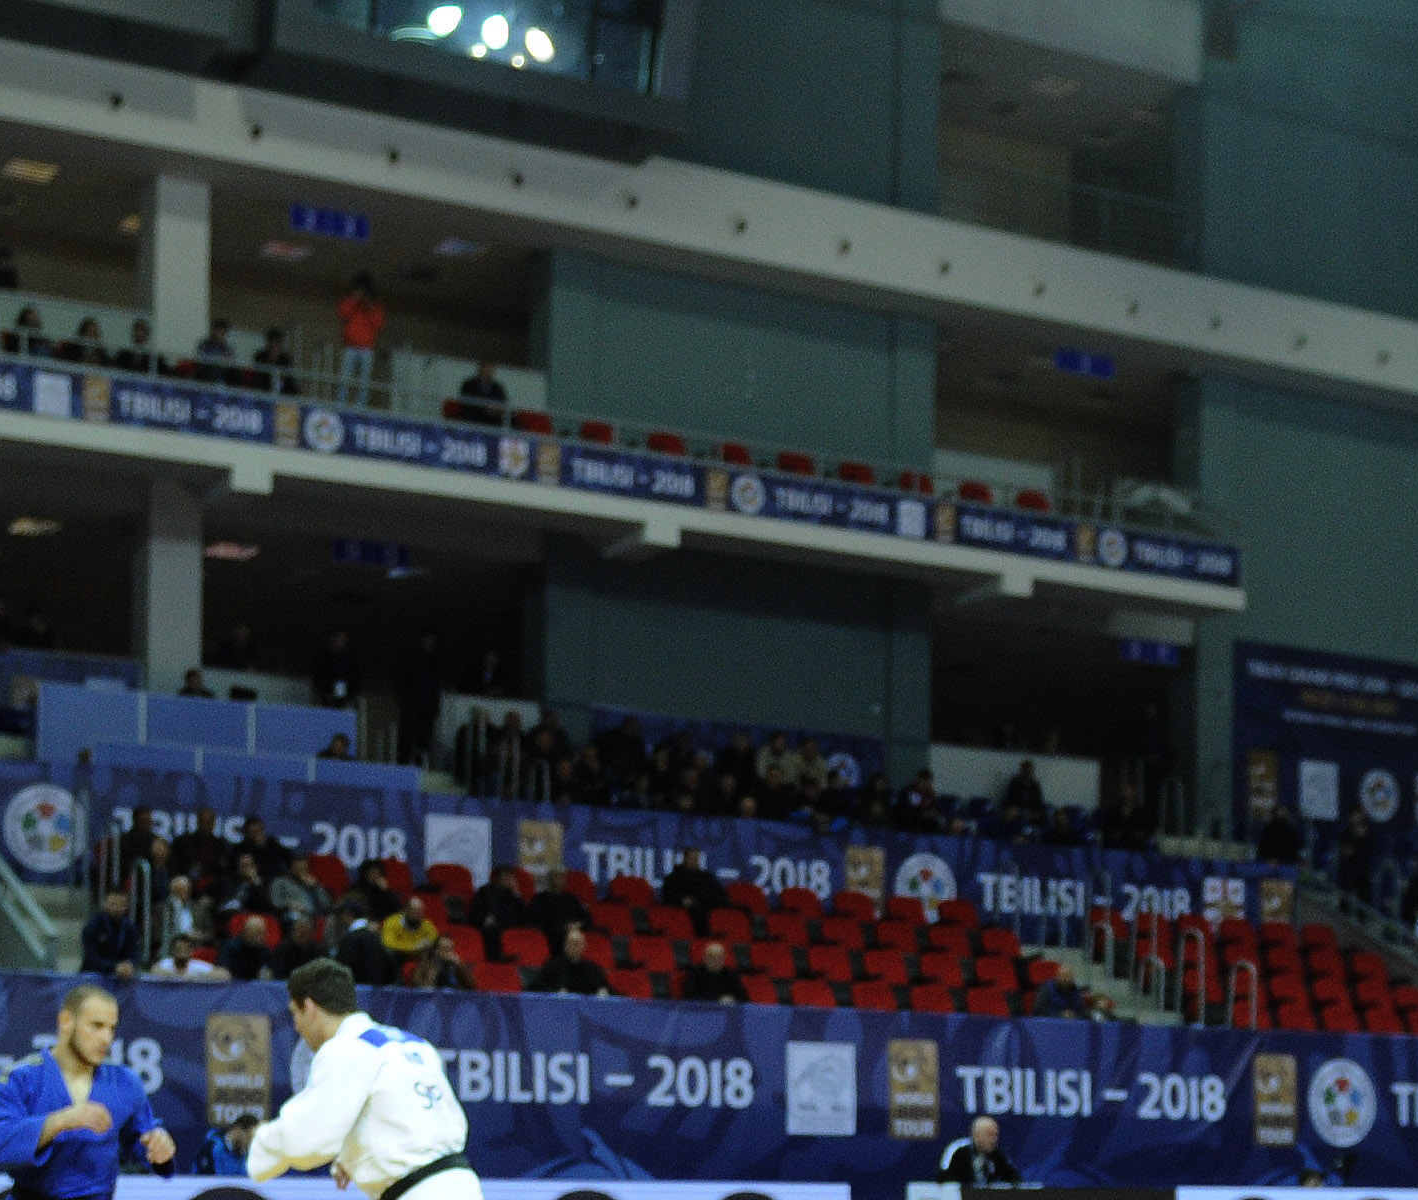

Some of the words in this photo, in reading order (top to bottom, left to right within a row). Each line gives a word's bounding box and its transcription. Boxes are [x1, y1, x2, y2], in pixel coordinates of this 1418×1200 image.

[311, 820, 406, 868] 2018
[748, 854, 831, 900] 2018
[647, 1056, 755, 1110] 2018
[956, 1065, 1092, 1117] TBILISI
[1137, 1073, 1227, 1122] 2018
